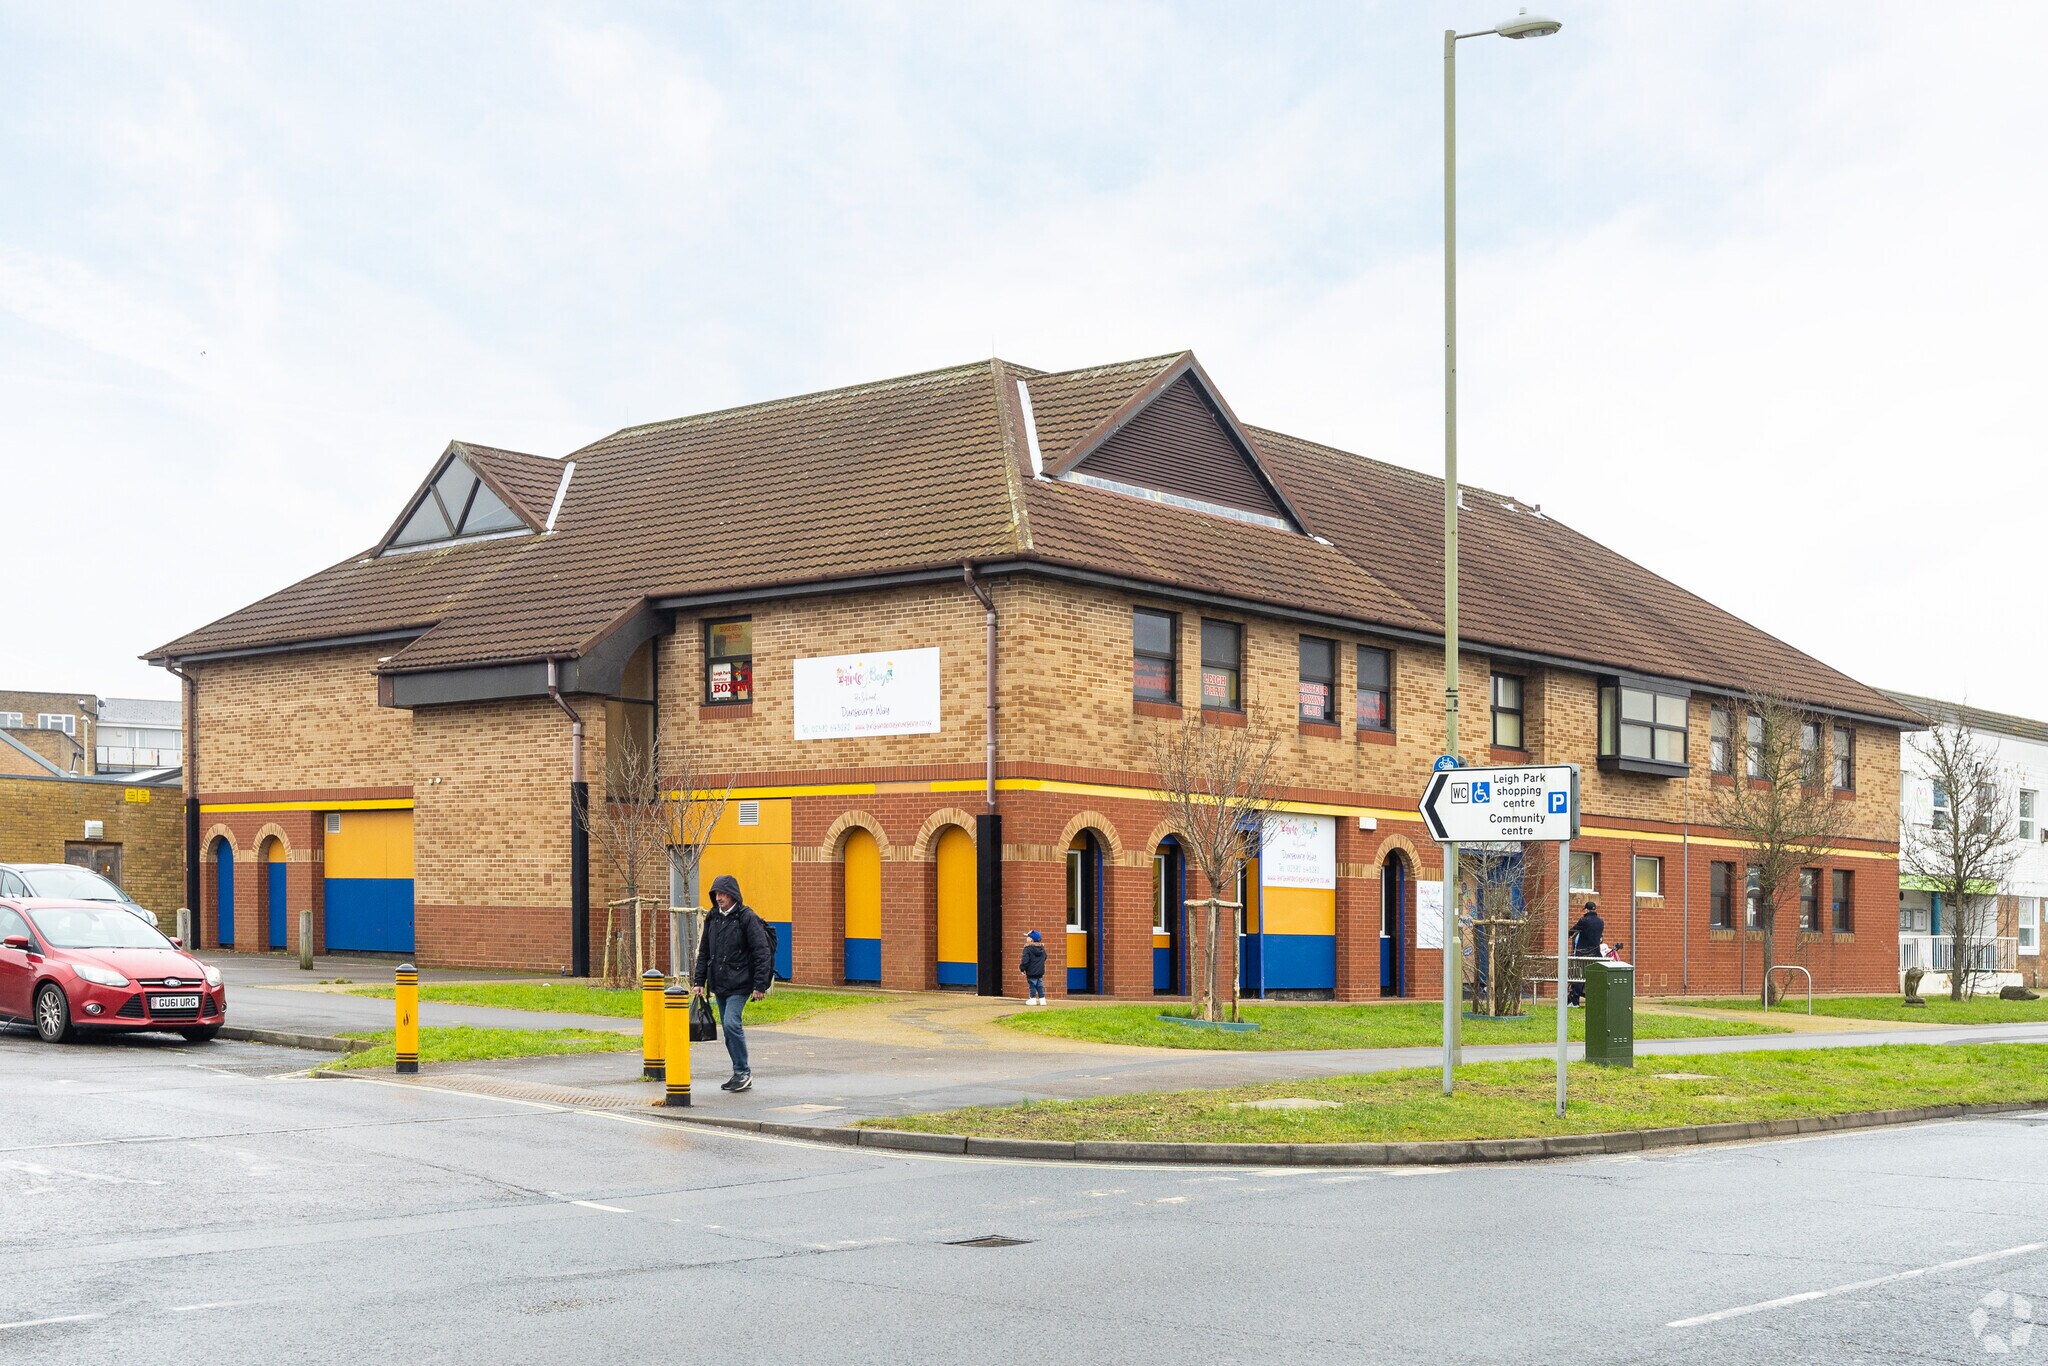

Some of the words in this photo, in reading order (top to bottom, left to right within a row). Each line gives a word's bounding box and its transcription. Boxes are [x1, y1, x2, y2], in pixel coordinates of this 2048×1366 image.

[1203, 673, 1226, 686] LEIGH
[1204, 685, 1226, 697] PARK
[1299, 683, 1328, 695] MATEUR
[875, 704, 890, 716] Way
[1303, 705, 1321, 716] CLUB
[1494, 774, 1519, 784] Leigh
[1523, 773, 1545, 782] Park
[1452, 787, 1467, 799] WC
[1497, 786, 1541, 796] shopping
[1503, 798, 1535, 807] centre
[1552, 793, 1565, 812] P
[1489, 813, 1545, 824] Community
[1501, 825, 1533, 835] centre
[159, 998, 178, 1008] GU61
[180, 997, 196, 1007] URG
